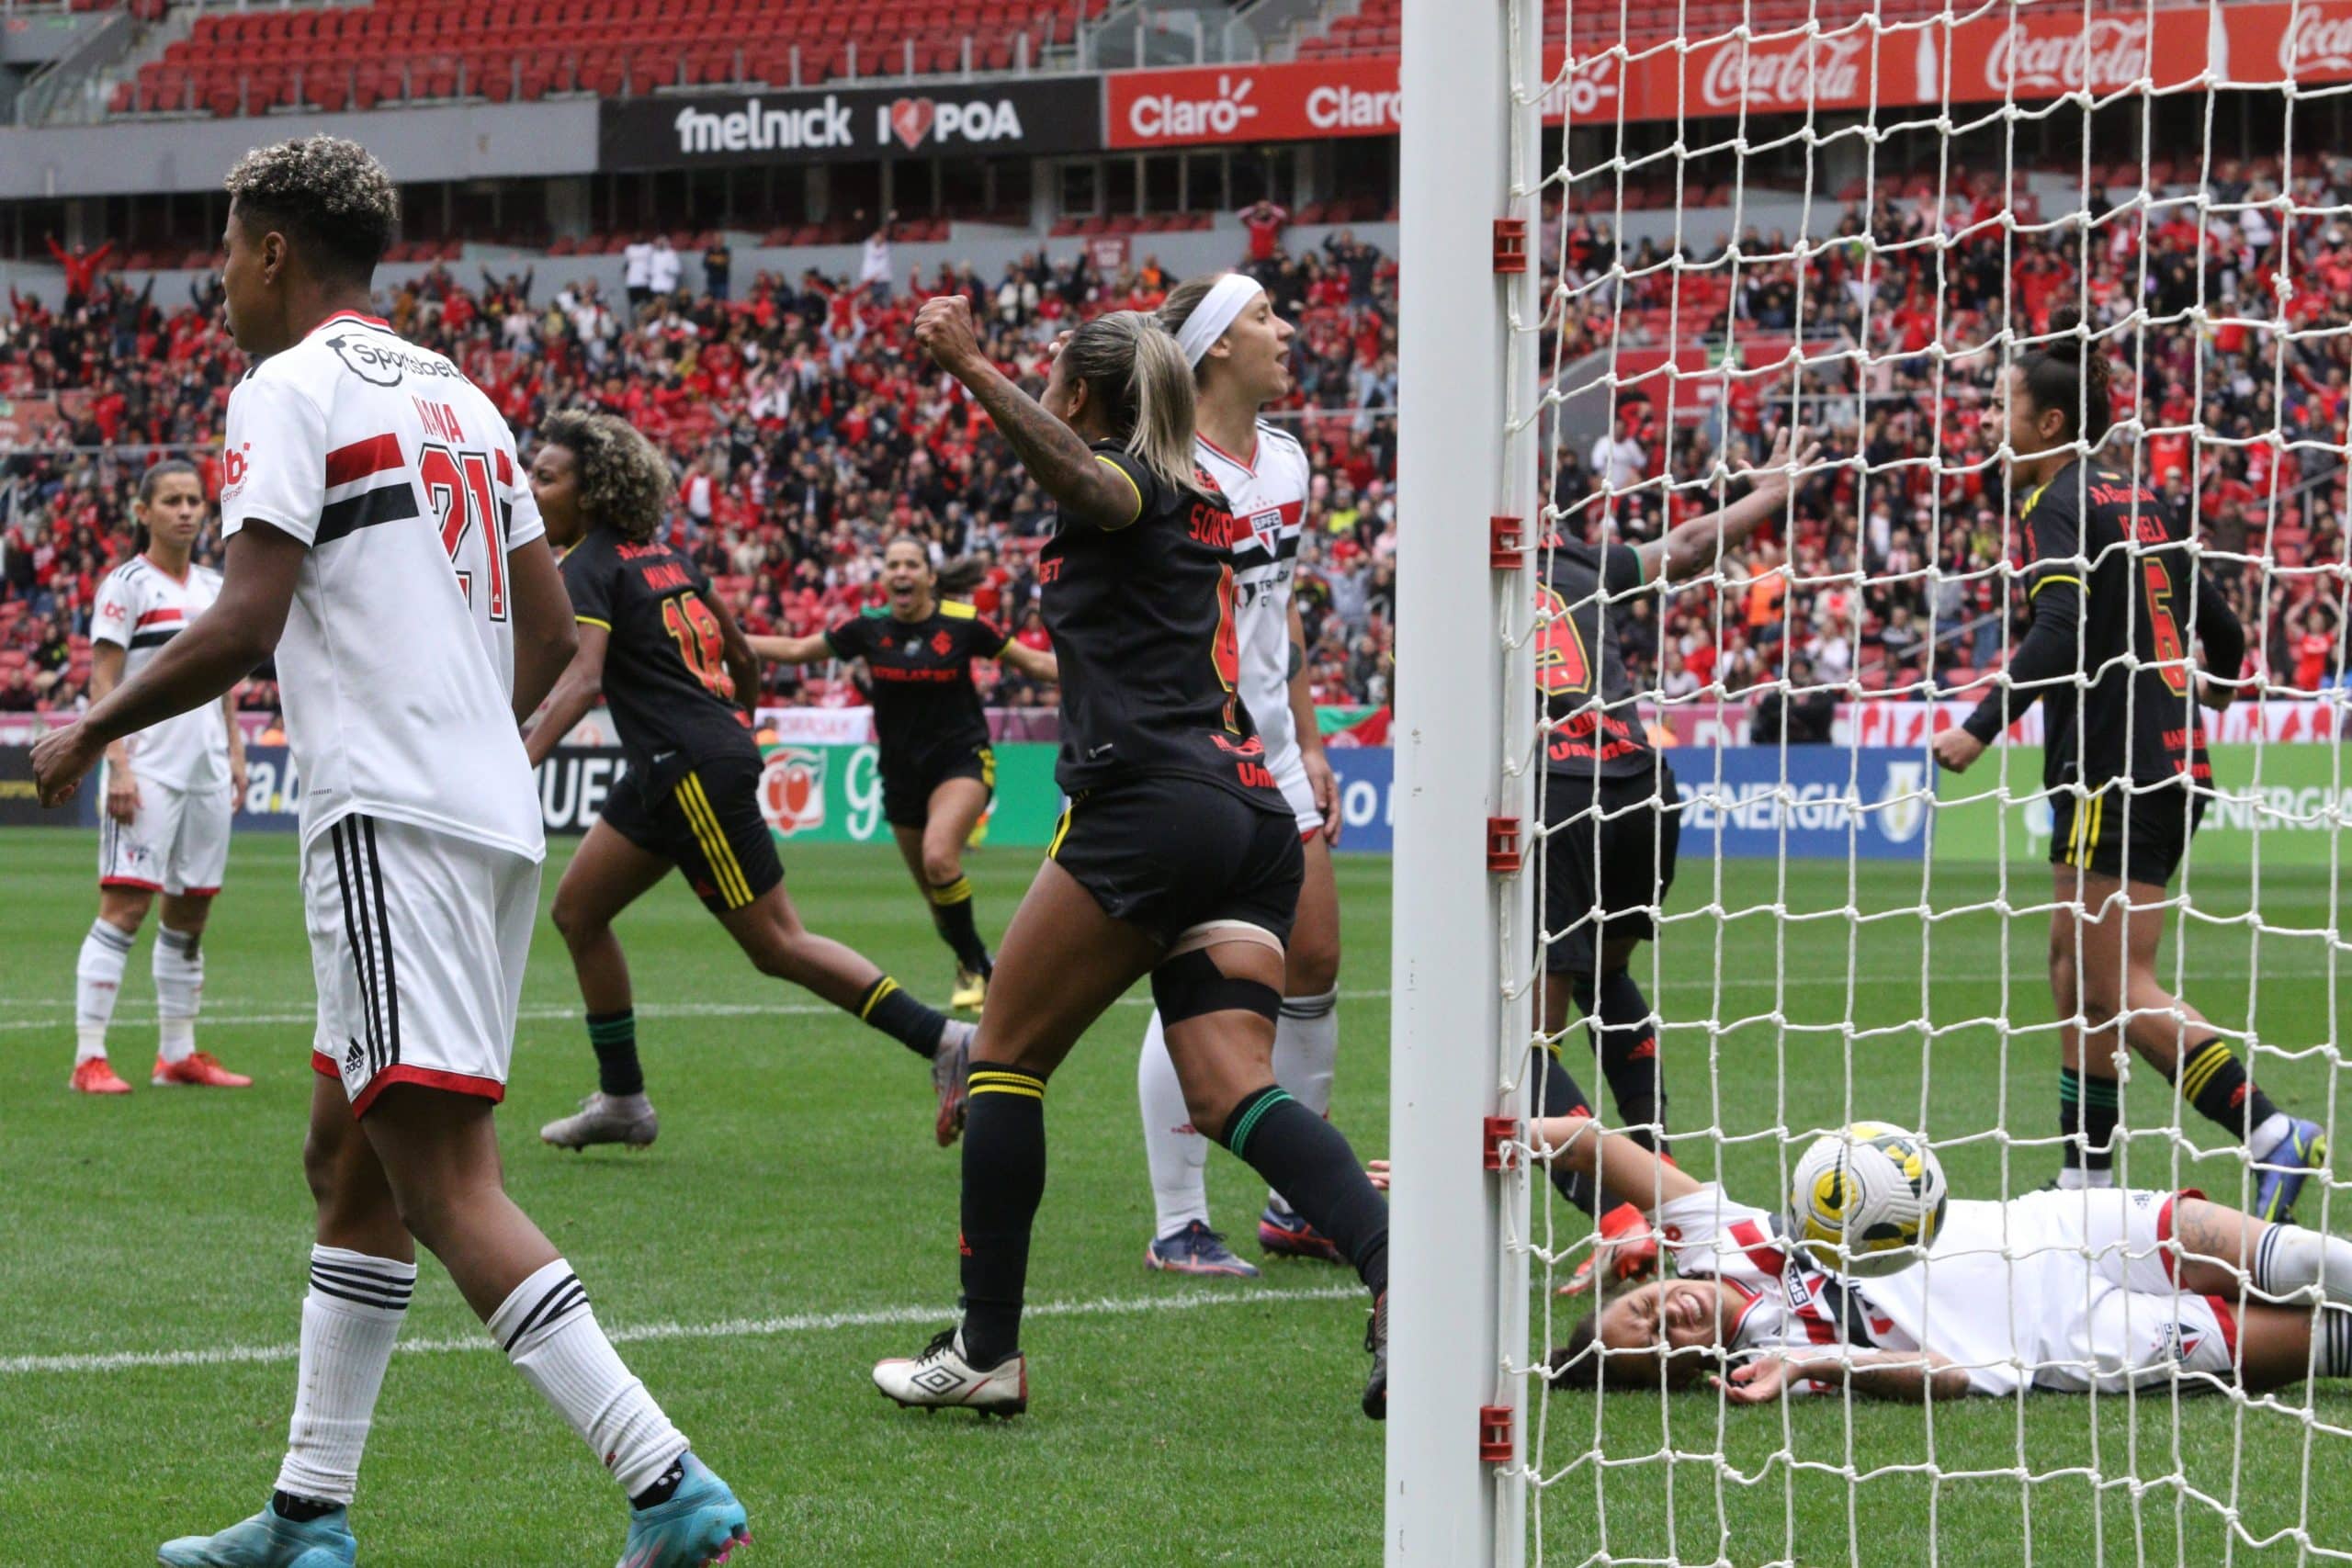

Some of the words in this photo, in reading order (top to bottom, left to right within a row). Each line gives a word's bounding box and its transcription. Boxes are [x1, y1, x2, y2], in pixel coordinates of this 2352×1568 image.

[1702, 36, 1867, 107] Coca-Cola
[1985, 18, 2148, 90] Coca-Cola
[675, 96, 853, 153] melnick
[877, 107, 889, 144] I
[934, 100, 1023, 143] POA
[1128, 96, 1238, 137] Claro
[419, 443, 506, 623] 21
[1252, 512, 1281, 532] SPFC
[2143, 558, 2187, 696] 6
